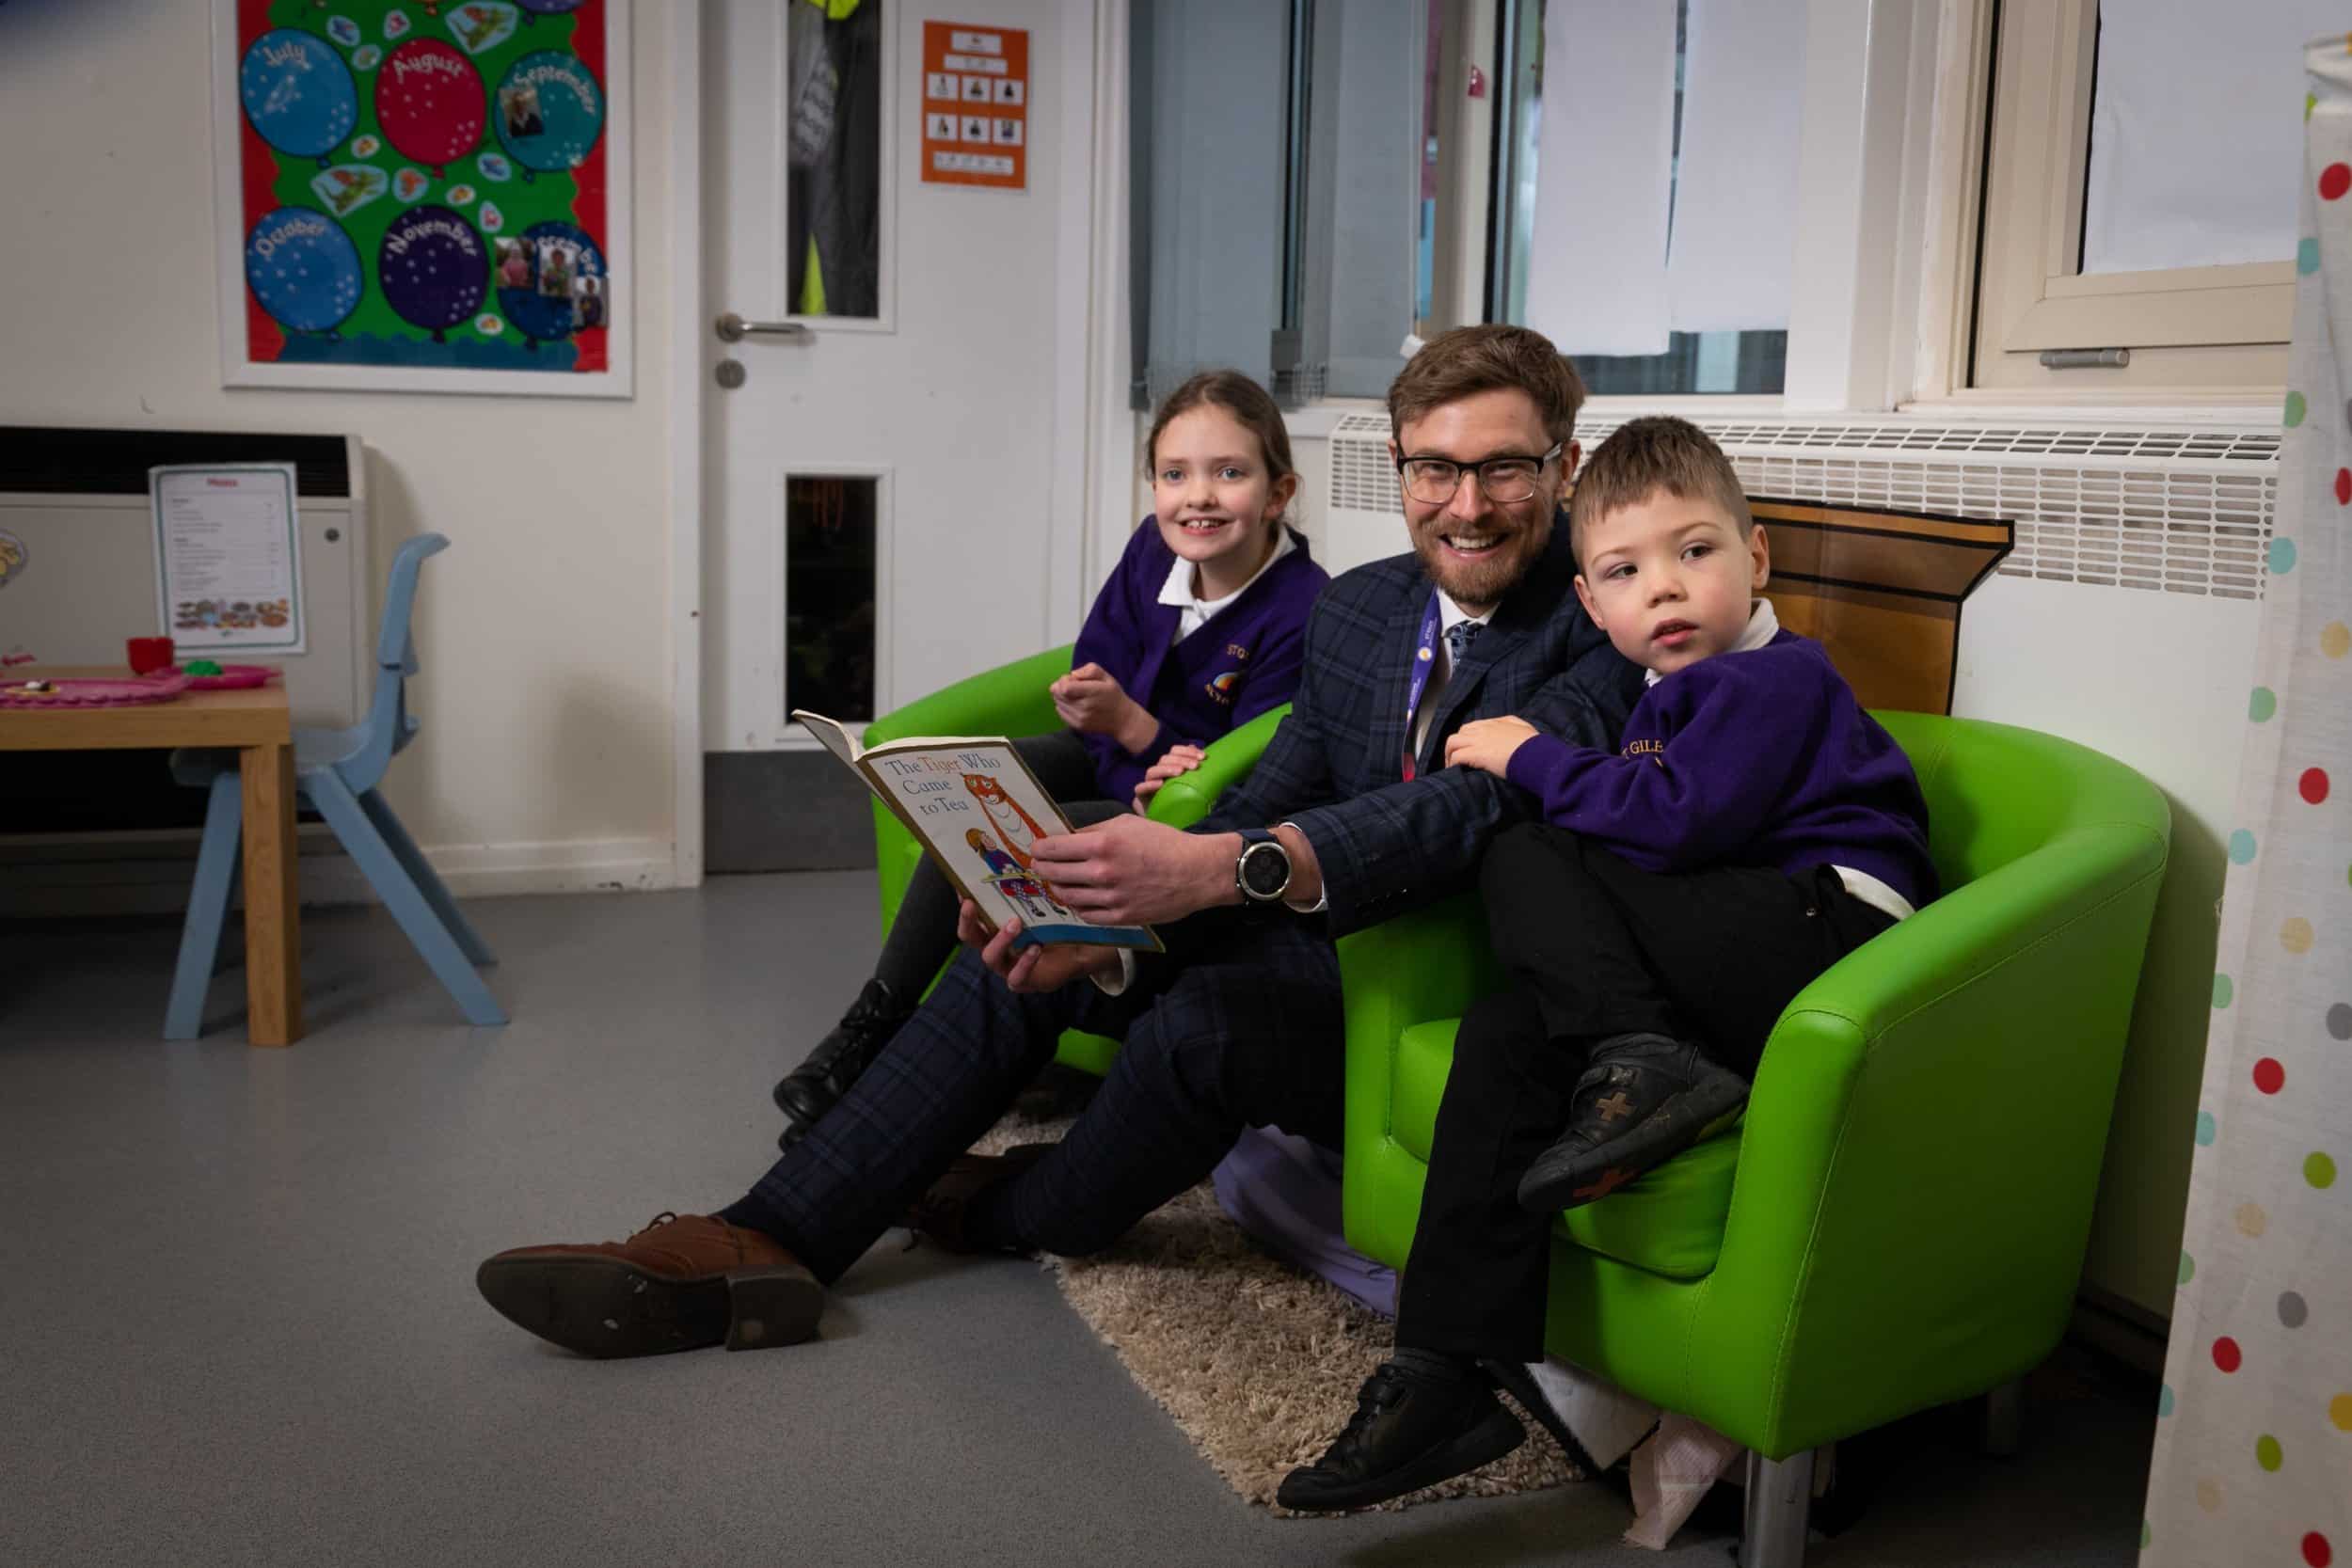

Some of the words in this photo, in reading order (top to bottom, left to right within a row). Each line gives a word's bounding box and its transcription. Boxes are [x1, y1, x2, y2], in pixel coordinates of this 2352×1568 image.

[262, 40, 311, 71] July
[392, 52, 463, 85] August
[513, 65, 596, 114] September
[255, 217, 326, 258] October
[385, 219, 477, 256] November
[1629, 739, 1664, 754] GILE
[885, 759, 924, 776] The
[918, 756, 961, 774] Tiger
[958, 752, 1001, 769] Who
[903, 780, 953, 796] Came
[919, 803, 940, 816] to
[934, 797, 970, 812] Tea
